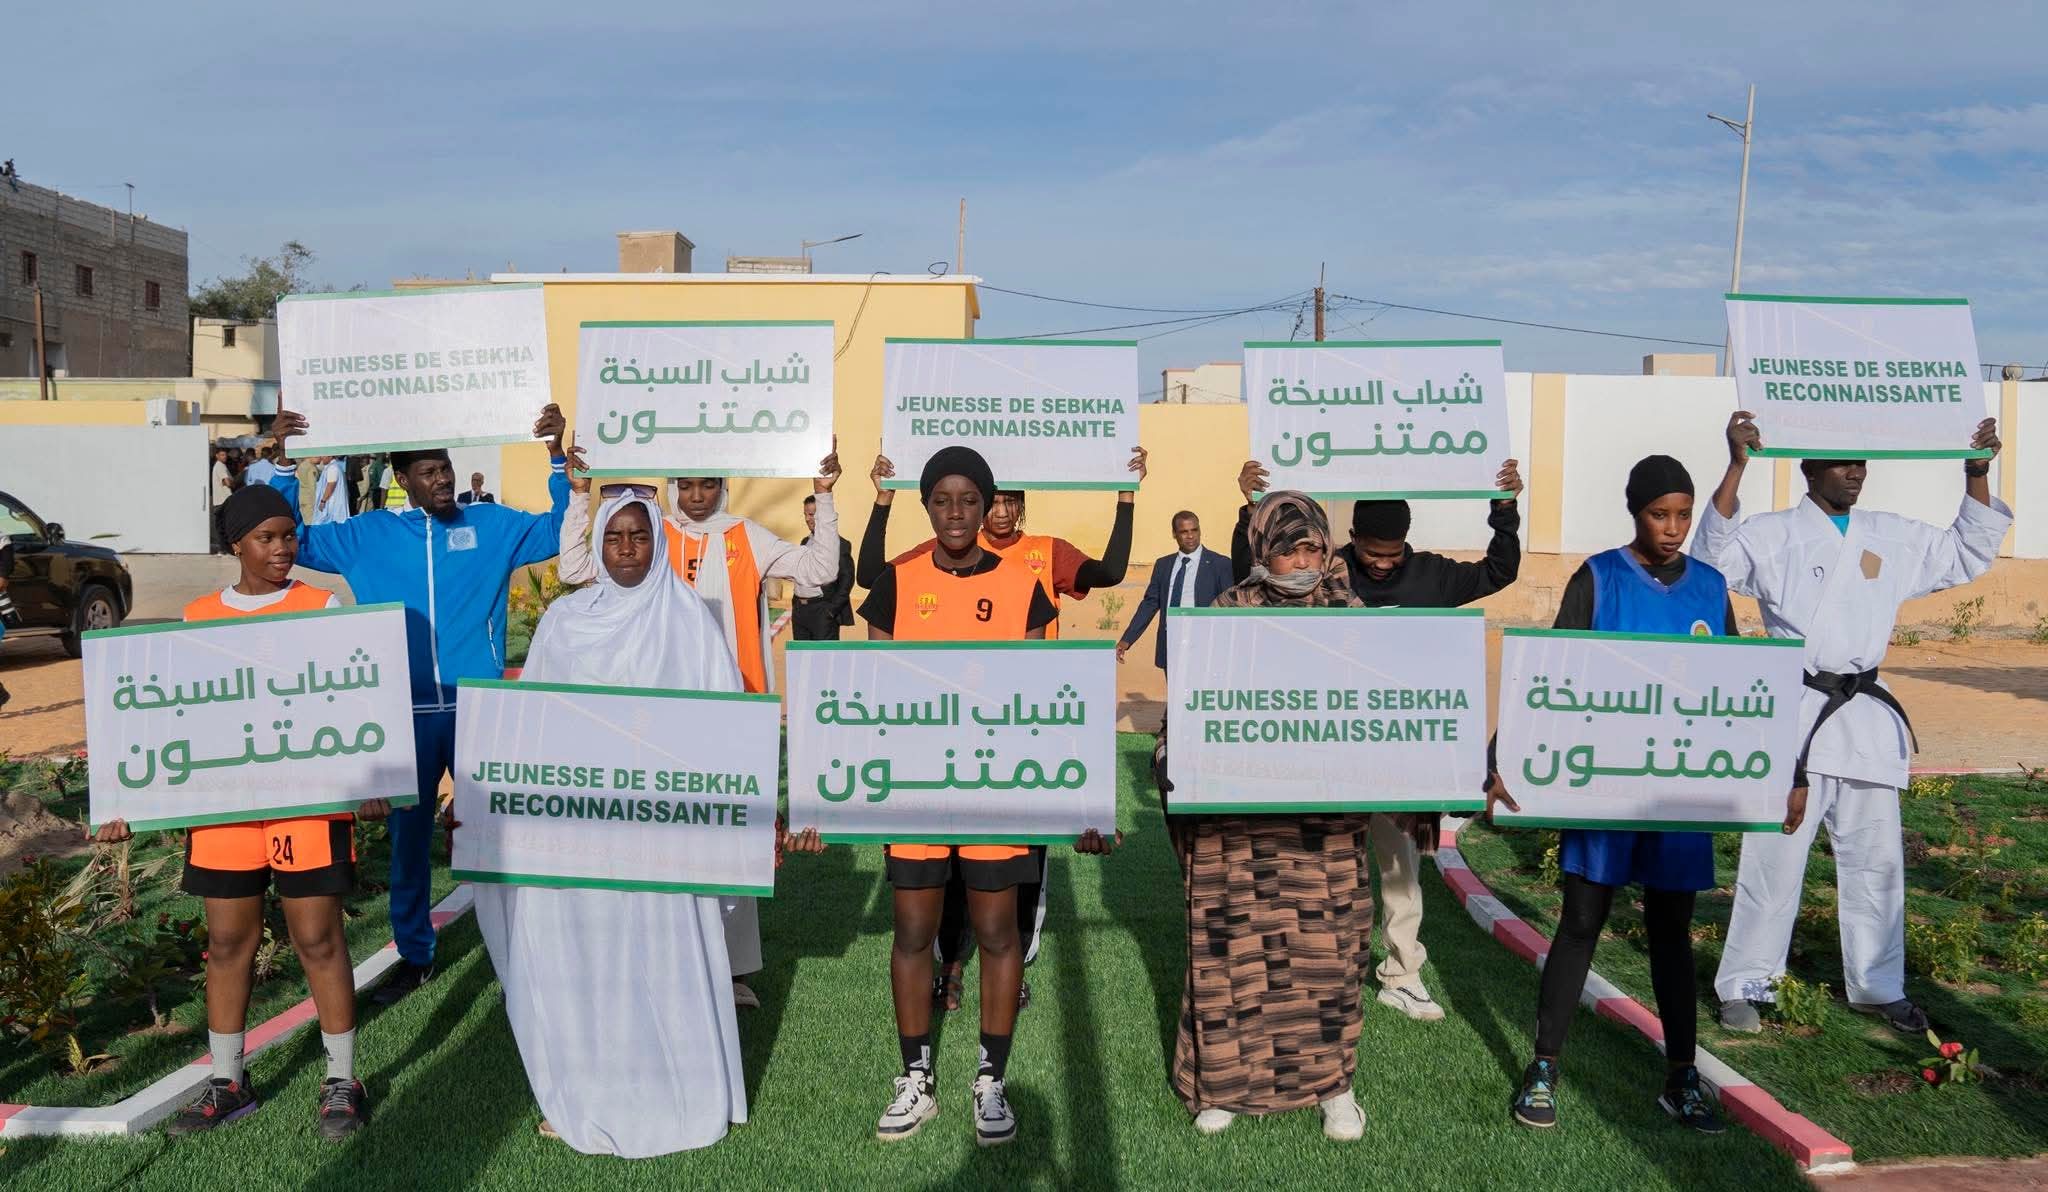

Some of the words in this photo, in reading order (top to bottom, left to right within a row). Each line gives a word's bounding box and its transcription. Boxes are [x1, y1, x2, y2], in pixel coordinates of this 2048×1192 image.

[296, 353, 408, 376] JEUNESSE
[414, 352, 441, 370] DE
[447, 346, 534, 368] SEBKHA
[599, 357, 712, 393] السبخة
[721, 352, 810, 393] شباب
[1749, 357, 1849, 377] JEUNESSE
[1854, 360, 1880, 378] DE
[1885, 361, 1968, 378] SEBKHA
[313, 369, 528, 400] RECONNAISSANTE
[1268, 378, 1384, 414] السبخة
[1392, 372, 1483, 413] شباب
[1765, 381, 1962, 403] RECONNAISSANTE
[896, 396, 1001, 413] JEUNESSE
[1009, 397, 1035, 414] DE
[1041, 398, 1125, 415] SEBKHA
[911, 418, 1116, 437] RECONNAISSANTE
[975, 598, 993, 622] 9
[112, 666, 256, 717] السبخة
[267, 647, 380, 706] شباب
[815, 689, 960, 736] السبخة
[971, 683, 1086, 736] شباب
[1185, 688, 1318, 711] JEUNESSE
[1327, 689, 1359, 710] DE
[1367, 688, 1469, 710] SEBKHA
[1526, 675, 1663, 723] السبخة
[1673, 678, 1775, 727] شباب
[1204, 718, 1458, 743] RECONNAISSANTE
[472, 761, 605, 789] JEUNESSE
[613, 768, 646, 790] DE
[654, 770, 760, 796] SEBKHA
[489, 791, 747, 827] RECONNAISSANTE
[272, 834, 294, 865] 24
